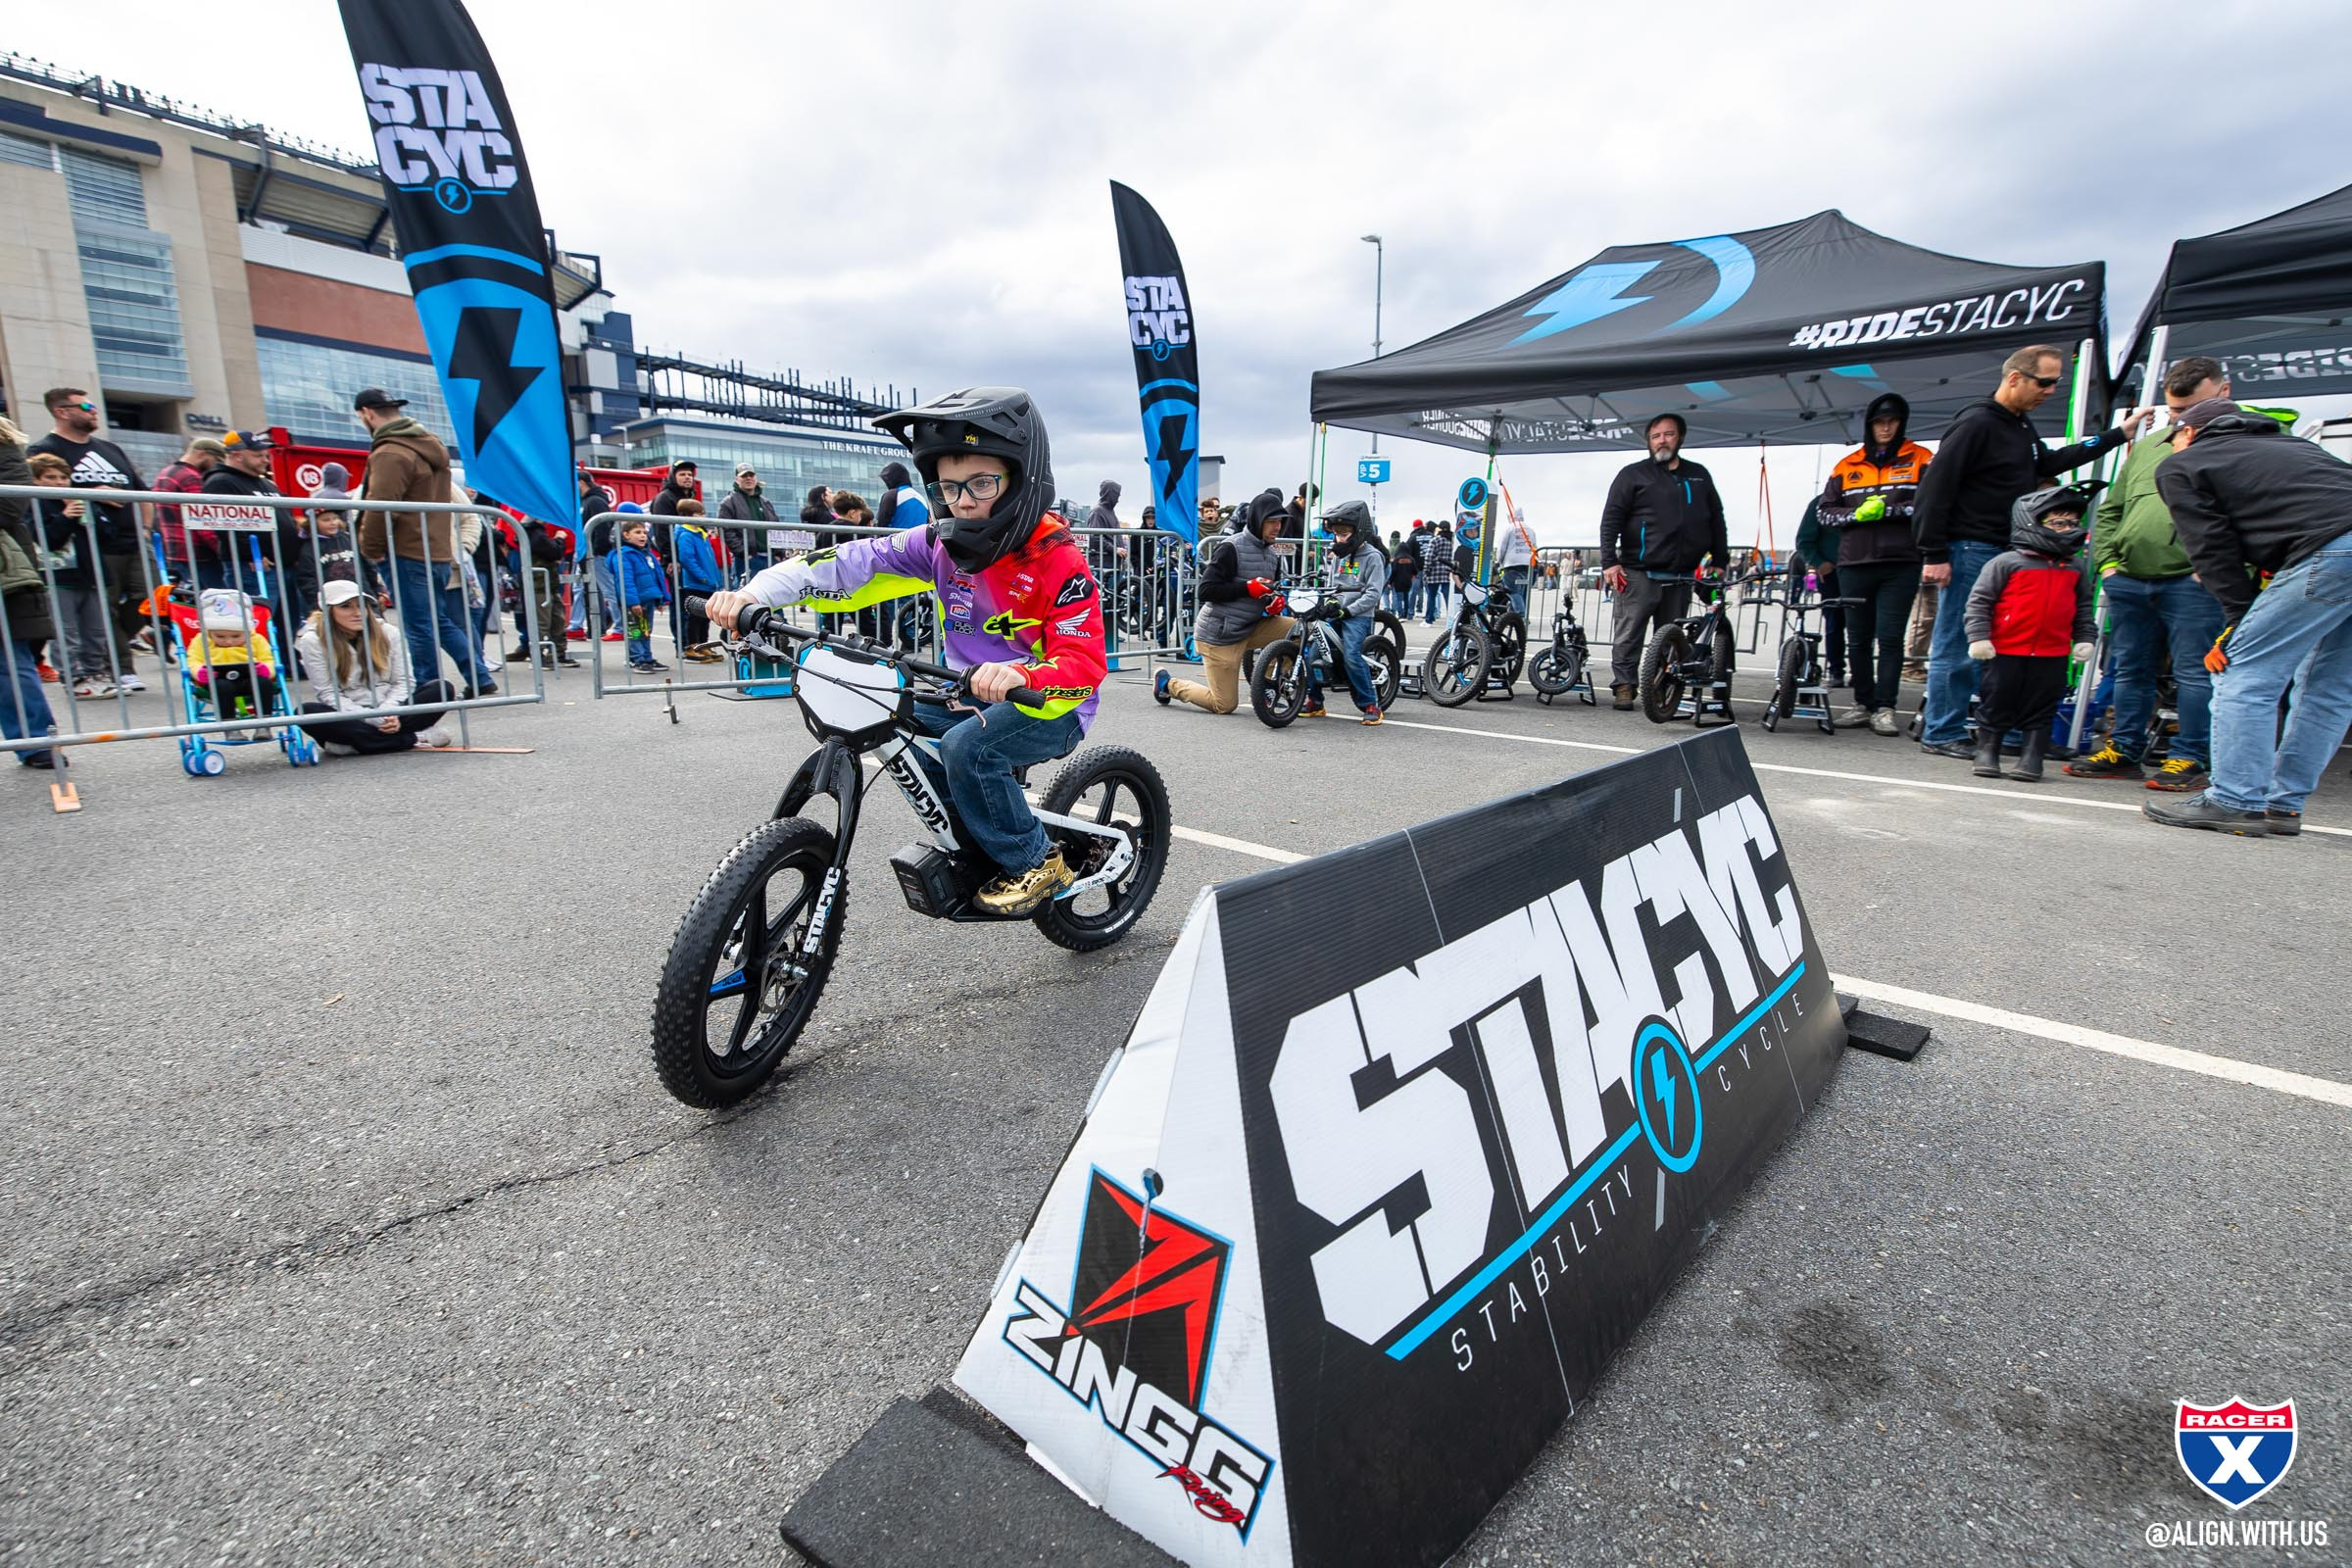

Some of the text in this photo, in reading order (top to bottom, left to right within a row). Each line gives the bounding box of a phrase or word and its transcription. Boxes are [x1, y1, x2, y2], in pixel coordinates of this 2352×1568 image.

[360, 63, 502, 129] STA
[375, 125, 518, 188] CYC
[1124, 275, 1186, 311] STA
[1788, 278, 2085, 350] #RIDESTACYC
[1129, 310, 1190, 345] CYC
[822, 440, 844, 451] THE
[846, 443, 881, 455] KRAFT
[1368, 464, 1380, 478] 5
[71, 471, 129, 484] adidas
[303, 471, 319, 484] 18
[188, 505, 271, 519] NATIONAL
[1055, 628, 1092, 638] HONDA
[803, 866, 841, 954] STACYC
[1270, 794, 1804, 1346] STACYC
[1450, 992, 1805, 1373] STABILITY CYCLE
[1005, 1283, 1268, 1529] ZINGG
[1154, 1455, 1248, 1526] Racing
